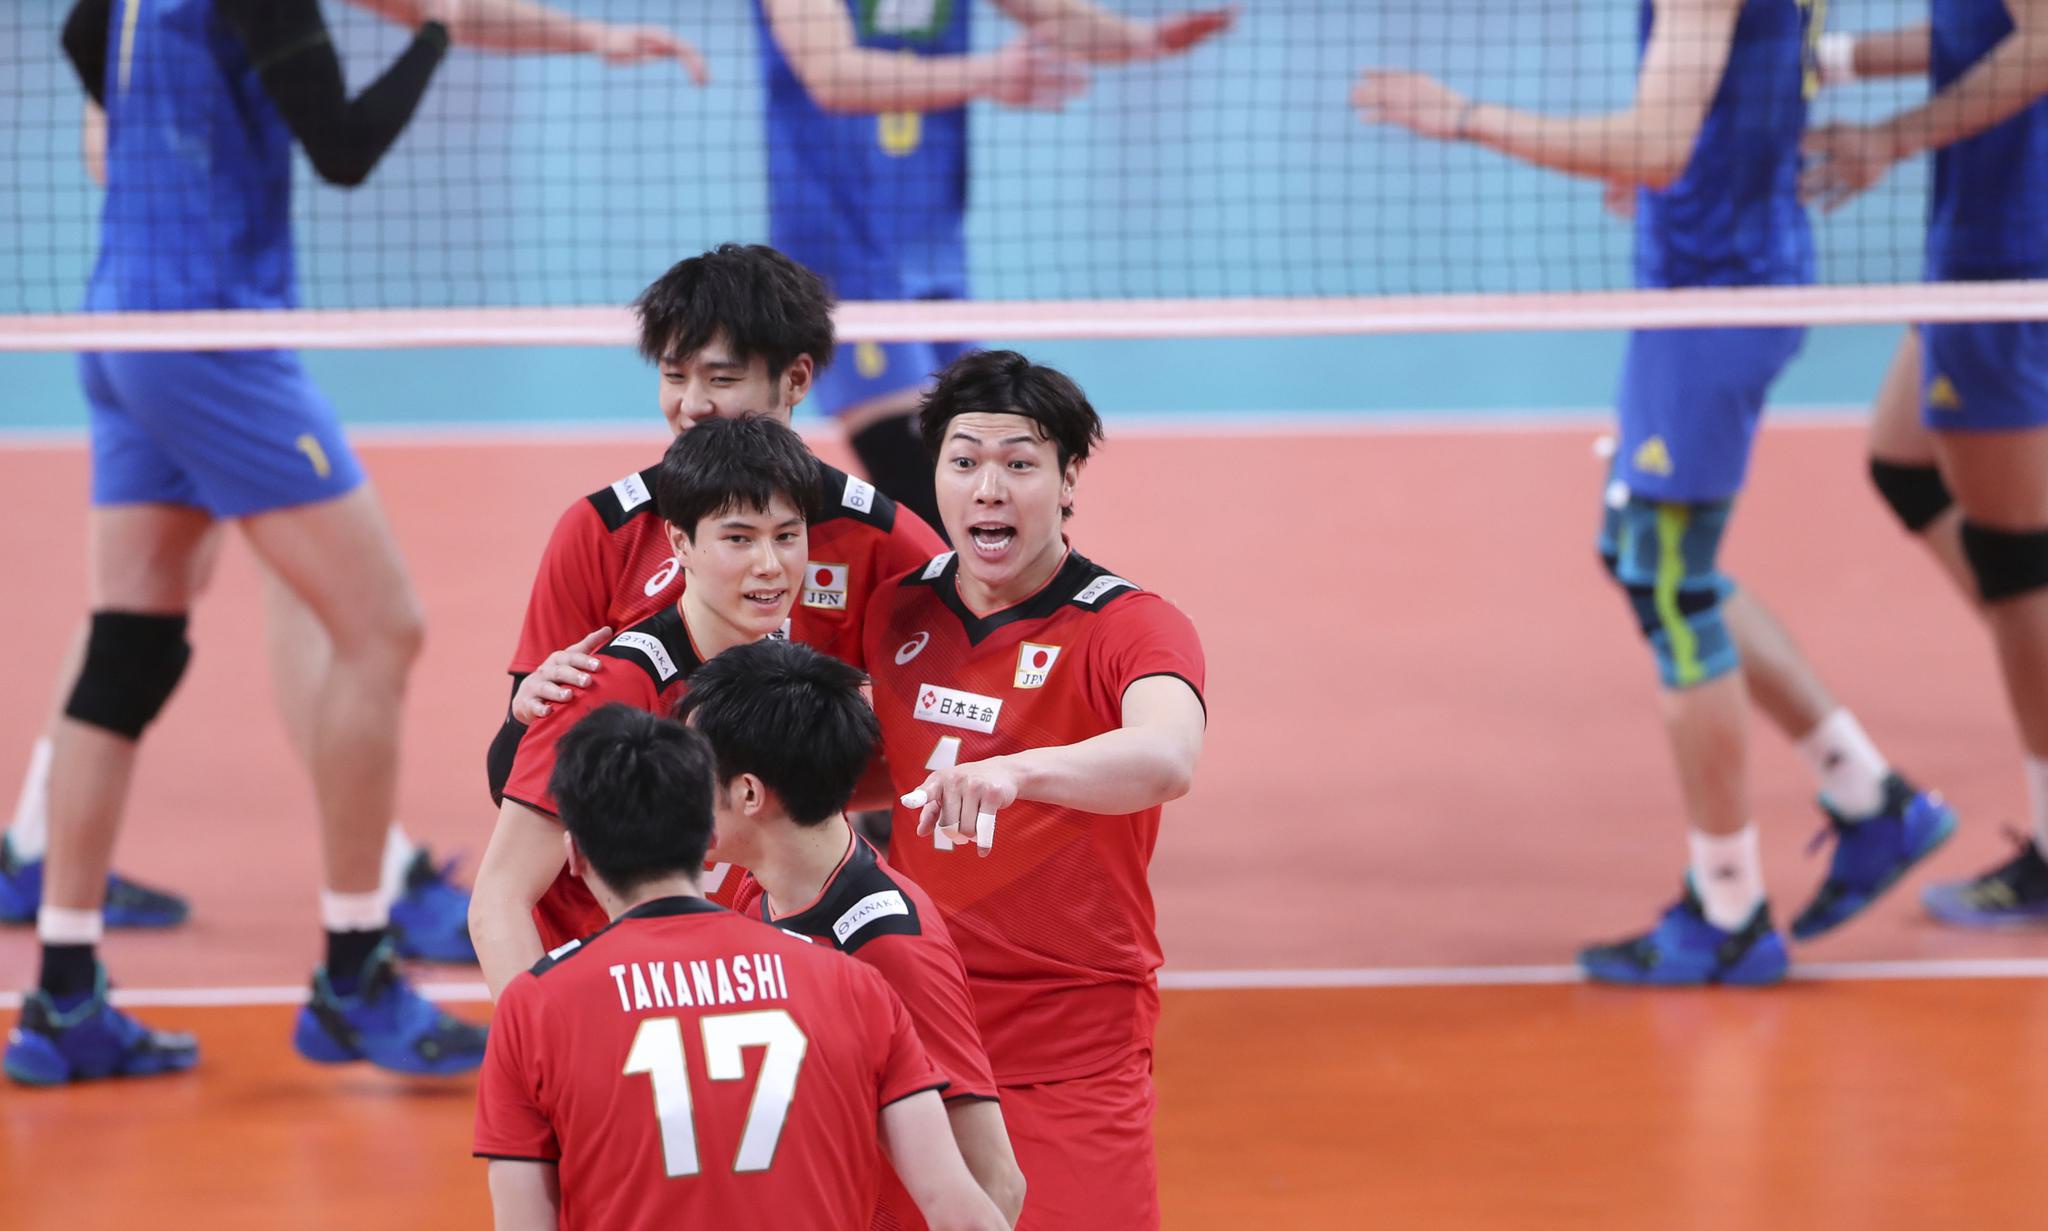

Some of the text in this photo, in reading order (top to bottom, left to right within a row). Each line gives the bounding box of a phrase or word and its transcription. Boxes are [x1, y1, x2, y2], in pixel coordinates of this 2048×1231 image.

[808, 592, 840, 605] JPN
[633, 637, 669, 675] TANAKA
[940, 698, 994, 723] 日本生命
[850, 899, 901, 922] TANAKA
[609, 954, 788, 1012] TAKANASHI
[622, 1009, 808, 1179] 17
